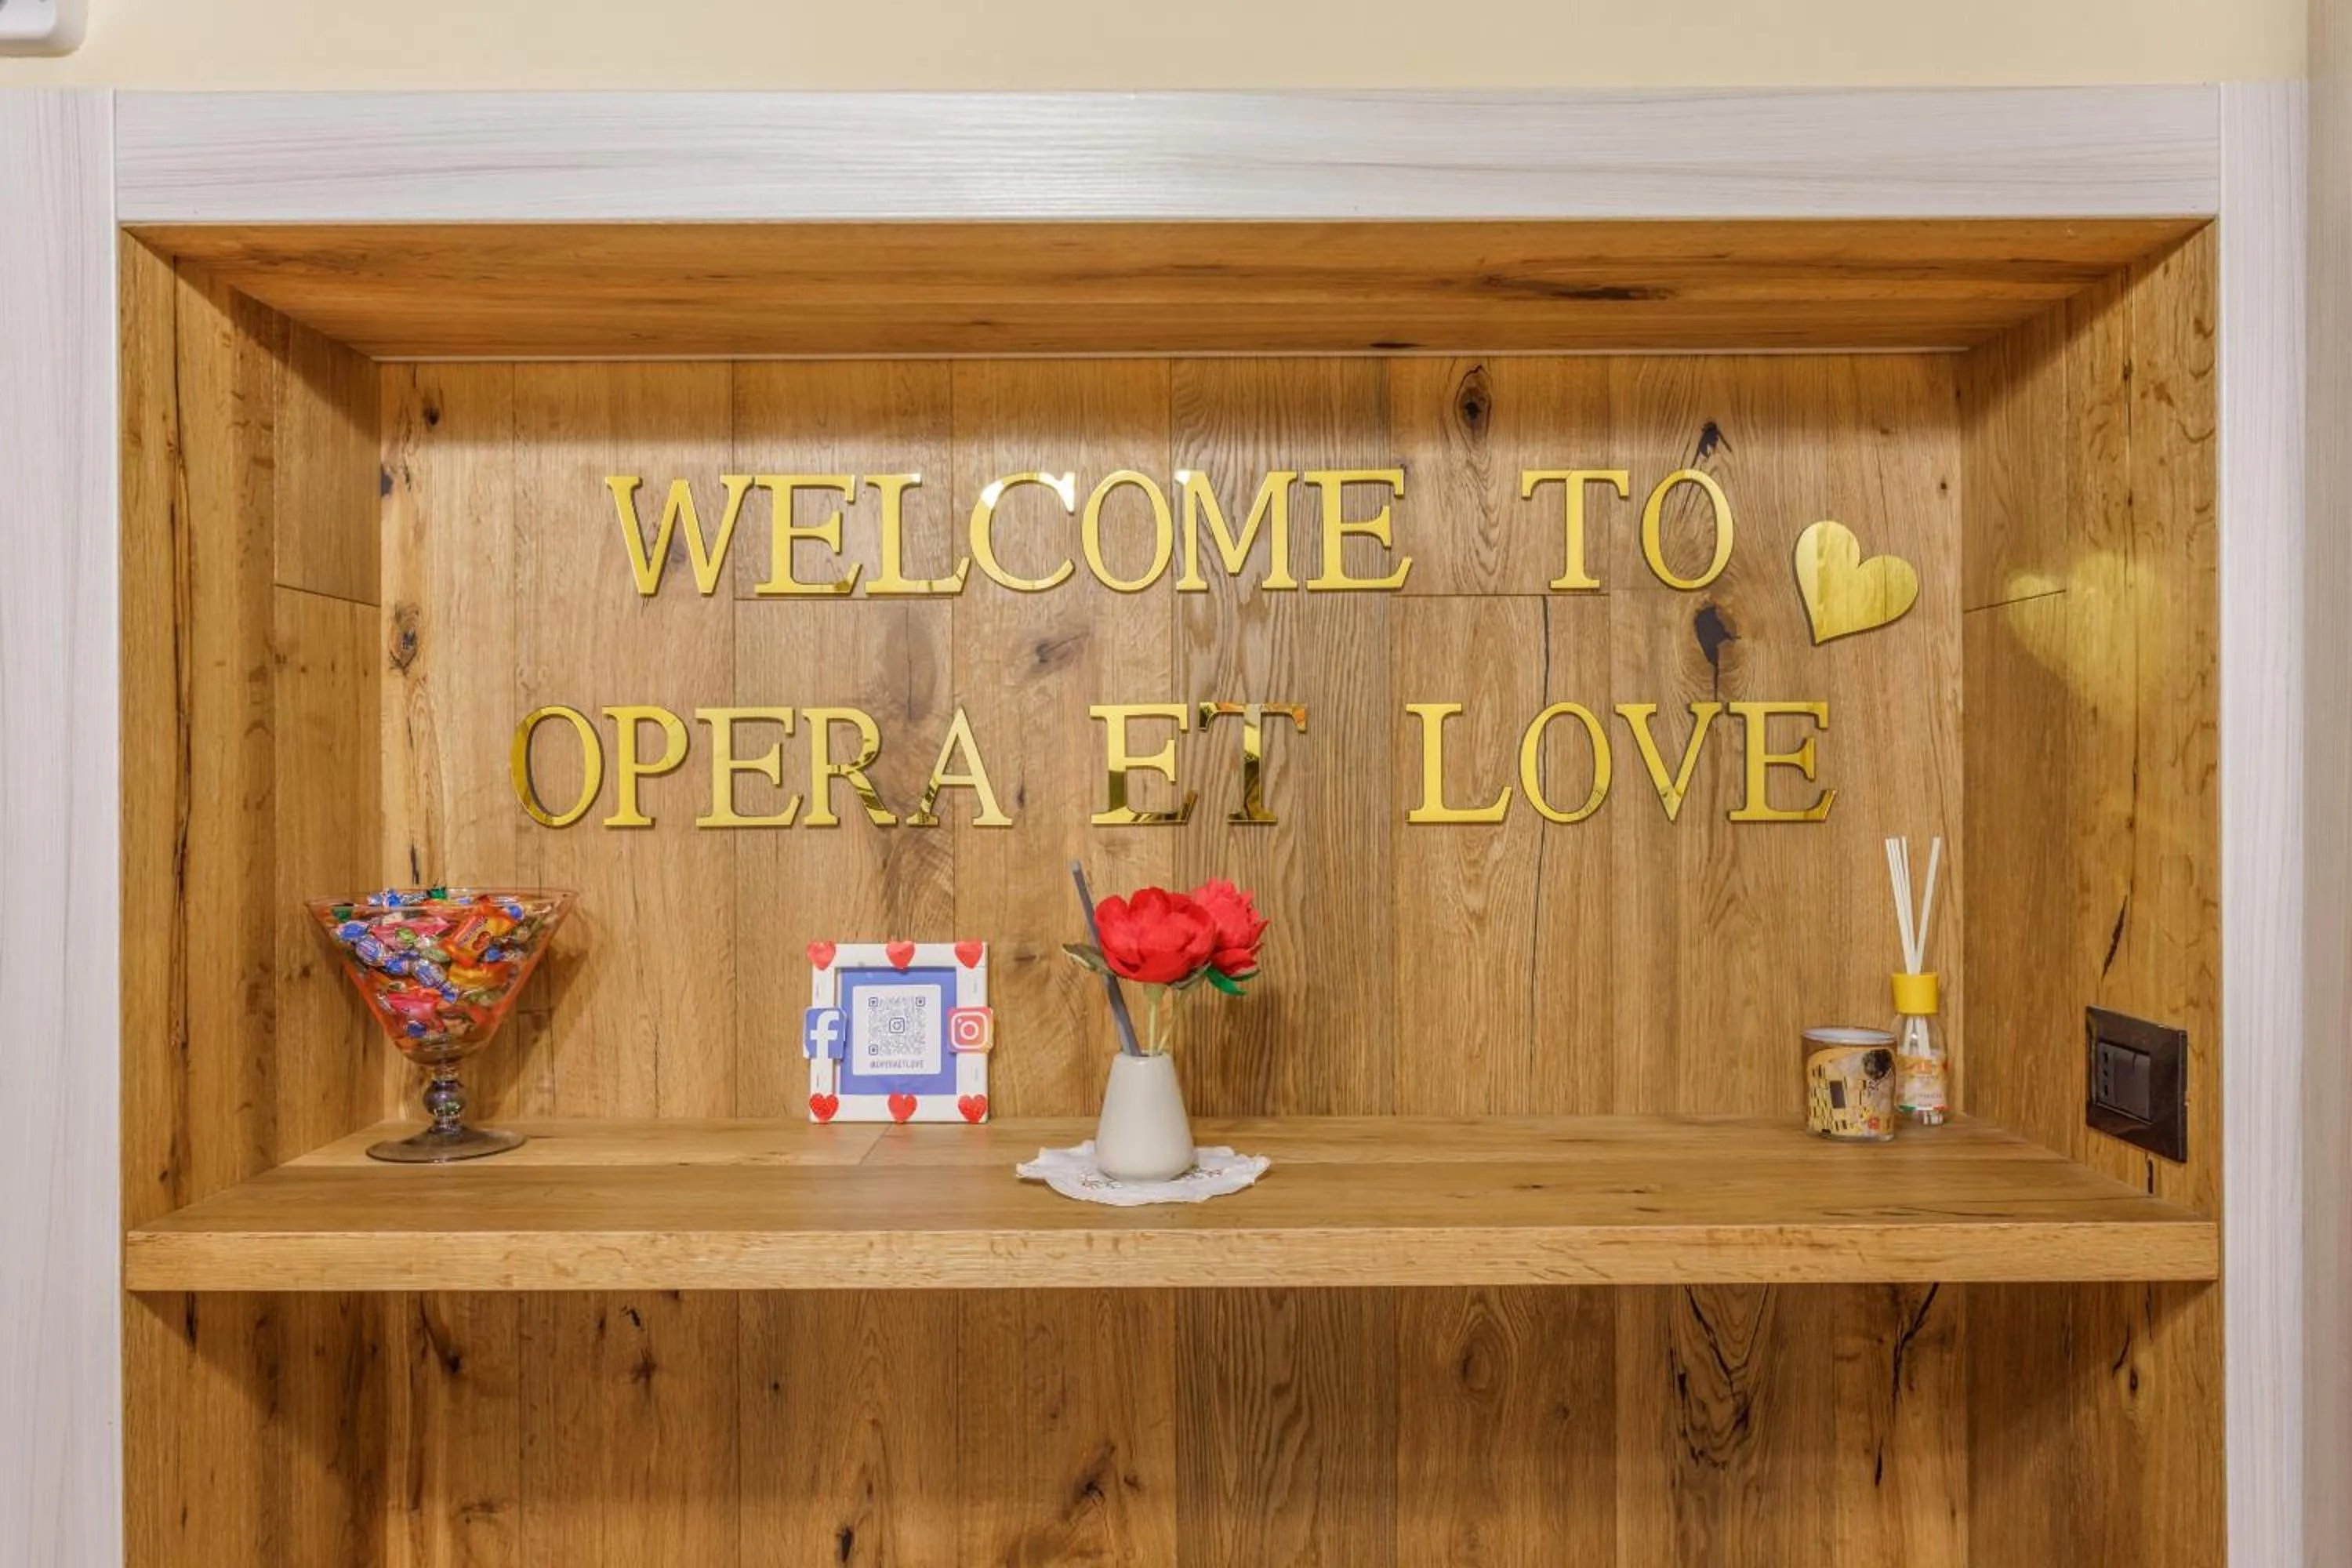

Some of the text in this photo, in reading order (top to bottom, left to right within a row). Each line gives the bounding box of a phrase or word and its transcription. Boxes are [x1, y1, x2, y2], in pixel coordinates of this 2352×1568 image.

[605, 468, 1734, 596] WELCOME TO
[511, 701, 1836, 827] OPERA ET LOVE
